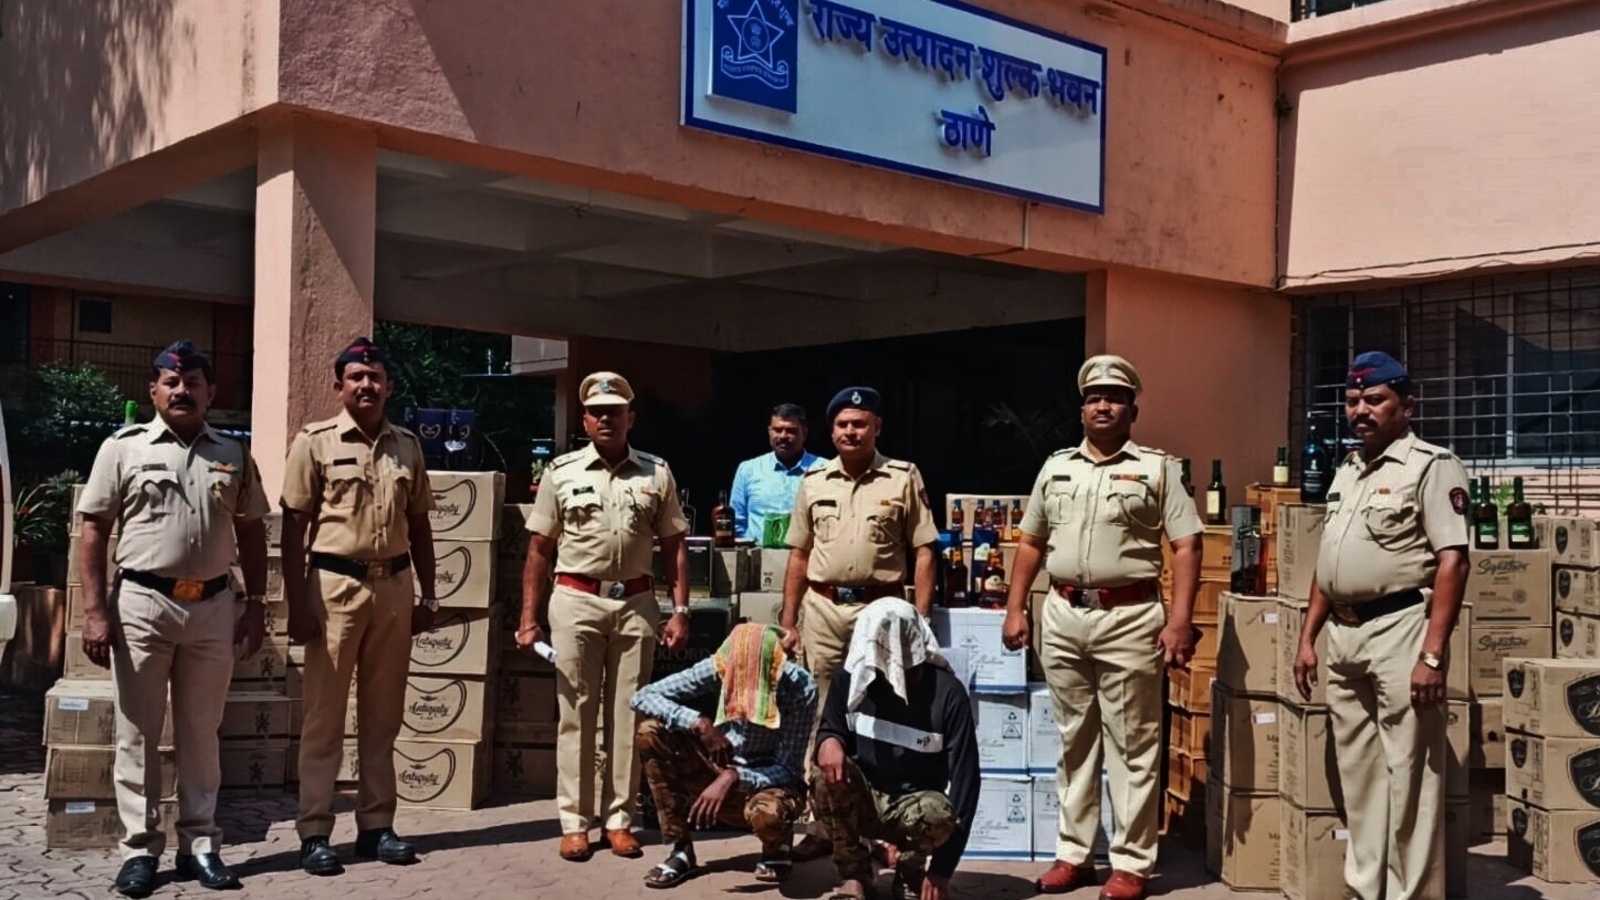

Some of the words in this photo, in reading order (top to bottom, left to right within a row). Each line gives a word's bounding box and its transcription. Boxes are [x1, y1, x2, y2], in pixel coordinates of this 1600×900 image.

[808, 0, 877, 53] राज्य
[879, 16, 977, 82] उत्पादन
[978, 46, 1043, 102] शुल्क
[1046, 67, 1101, 115] भवन
[940, 104, 996, 157] ठाणे
[1476, 558, 1530, 575] Signature
[1476, 635, 1530, 652] Signature
[408, 701, 451, 717] Antiquity
[398, 769, 440, 786] Antiquity
